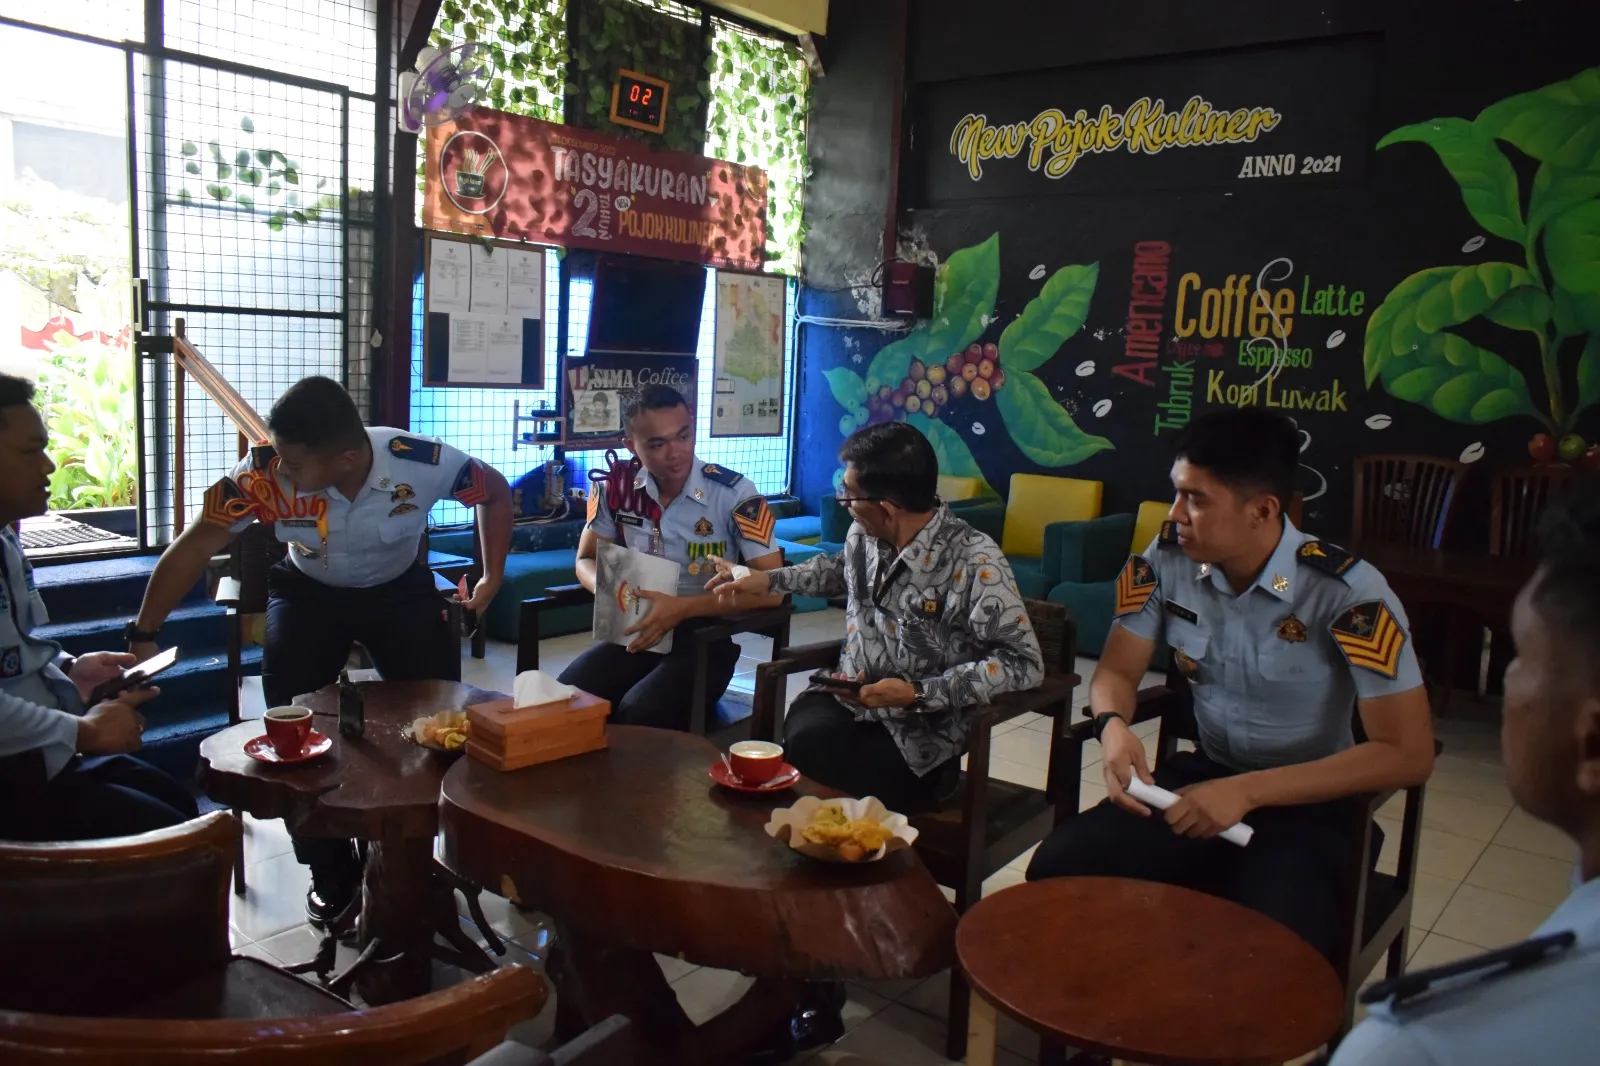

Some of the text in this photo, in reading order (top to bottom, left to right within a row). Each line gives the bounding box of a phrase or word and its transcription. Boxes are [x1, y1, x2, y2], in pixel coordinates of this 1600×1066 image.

[950, 95, 1282, 182] New Pojok Kuliner
[551, 146, 708, 205] TASYAKURAN
[1238, 154, 1342, 180] ANNO 2021
[571, 189, 598, 239] 2
[598, 193, 613, 241] TAHUN
[1174, 271, 1296, 340] Coffee
[1300, 275, 1365, 317] Latte
[638, 367, 689, 386] Coffee
[1237, 339, 1313, 373] Espresso
[1153, 359, 1195, 437] Tubruk
[1206, 369, 1349, 412] Kopi Luwak
